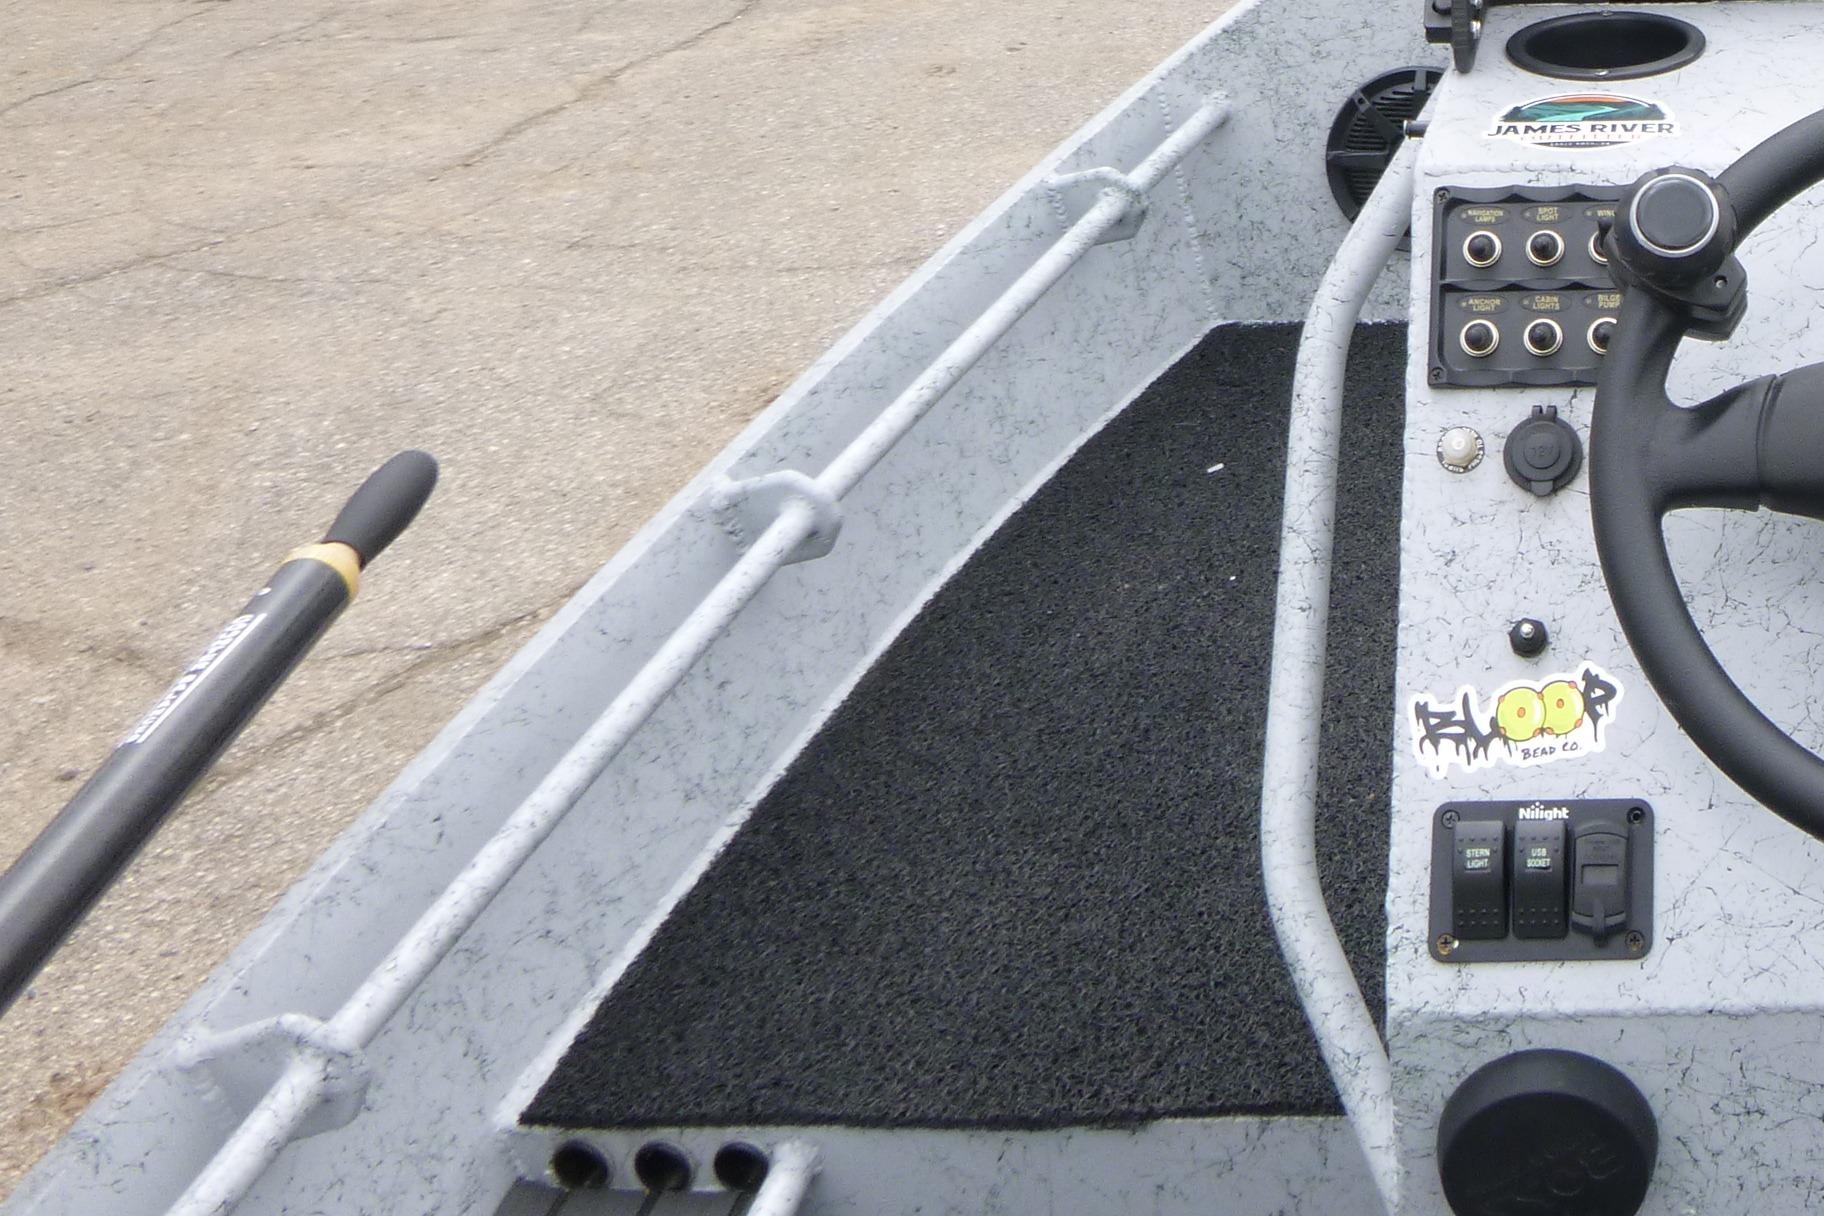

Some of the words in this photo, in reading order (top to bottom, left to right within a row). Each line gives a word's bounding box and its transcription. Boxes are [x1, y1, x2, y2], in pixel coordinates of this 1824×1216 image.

[1488, 124, 1581, 137] JAMES
[1590, 123, 1674, 134] RIVER
[1536, 213, 1559, 222] LIGHT
[1468, 298, 1501, 306] ANCHOR
[1532, 302, 1561, 311] LIGHTS
[1472, 304, 1496, 312] LIGHT
[1521, 745, 1557, 761] BEAD
[1518, 802, 1570, 821] Nilight
[1466, 848, 1491, 858] STERN
[1531, 848, 1547, 857] USB
[1467, 858, 1490, 869] LIGHT
[1526, 858, 1551, 867] SOCKET
